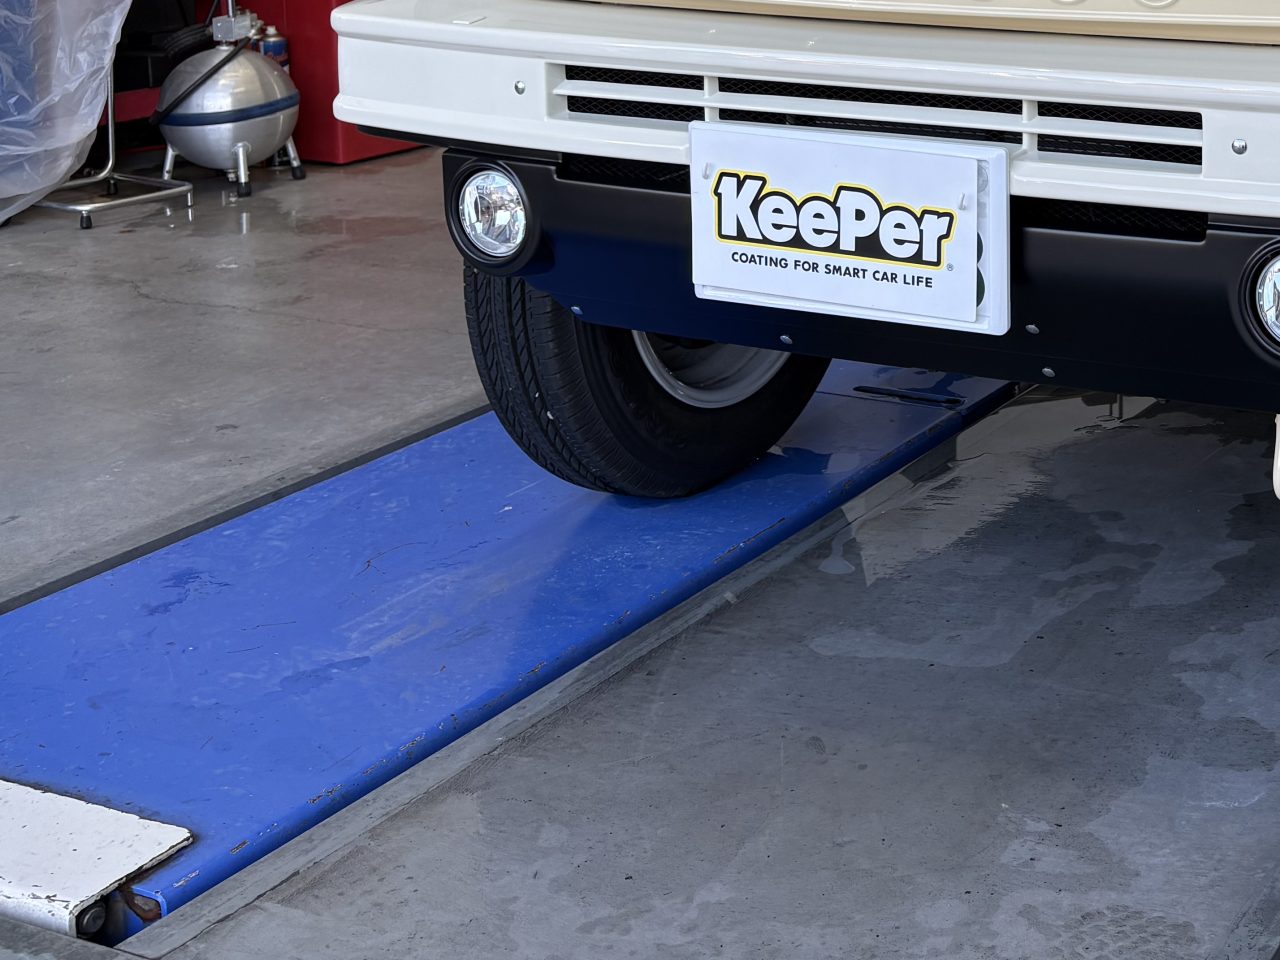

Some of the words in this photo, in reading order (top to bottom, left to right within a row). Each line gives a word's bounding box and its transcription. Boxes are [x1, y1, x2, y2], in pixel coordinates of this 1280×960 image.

[716, 173, 953, 265] KeePer
[731, 250, 789, 270] COATING
[793, 259, 820, 274] FOR
[824, 263, 868, 281] SMART
[872, 270, 899, 284] CAR
[903, 274, 934, 289] LIFE
